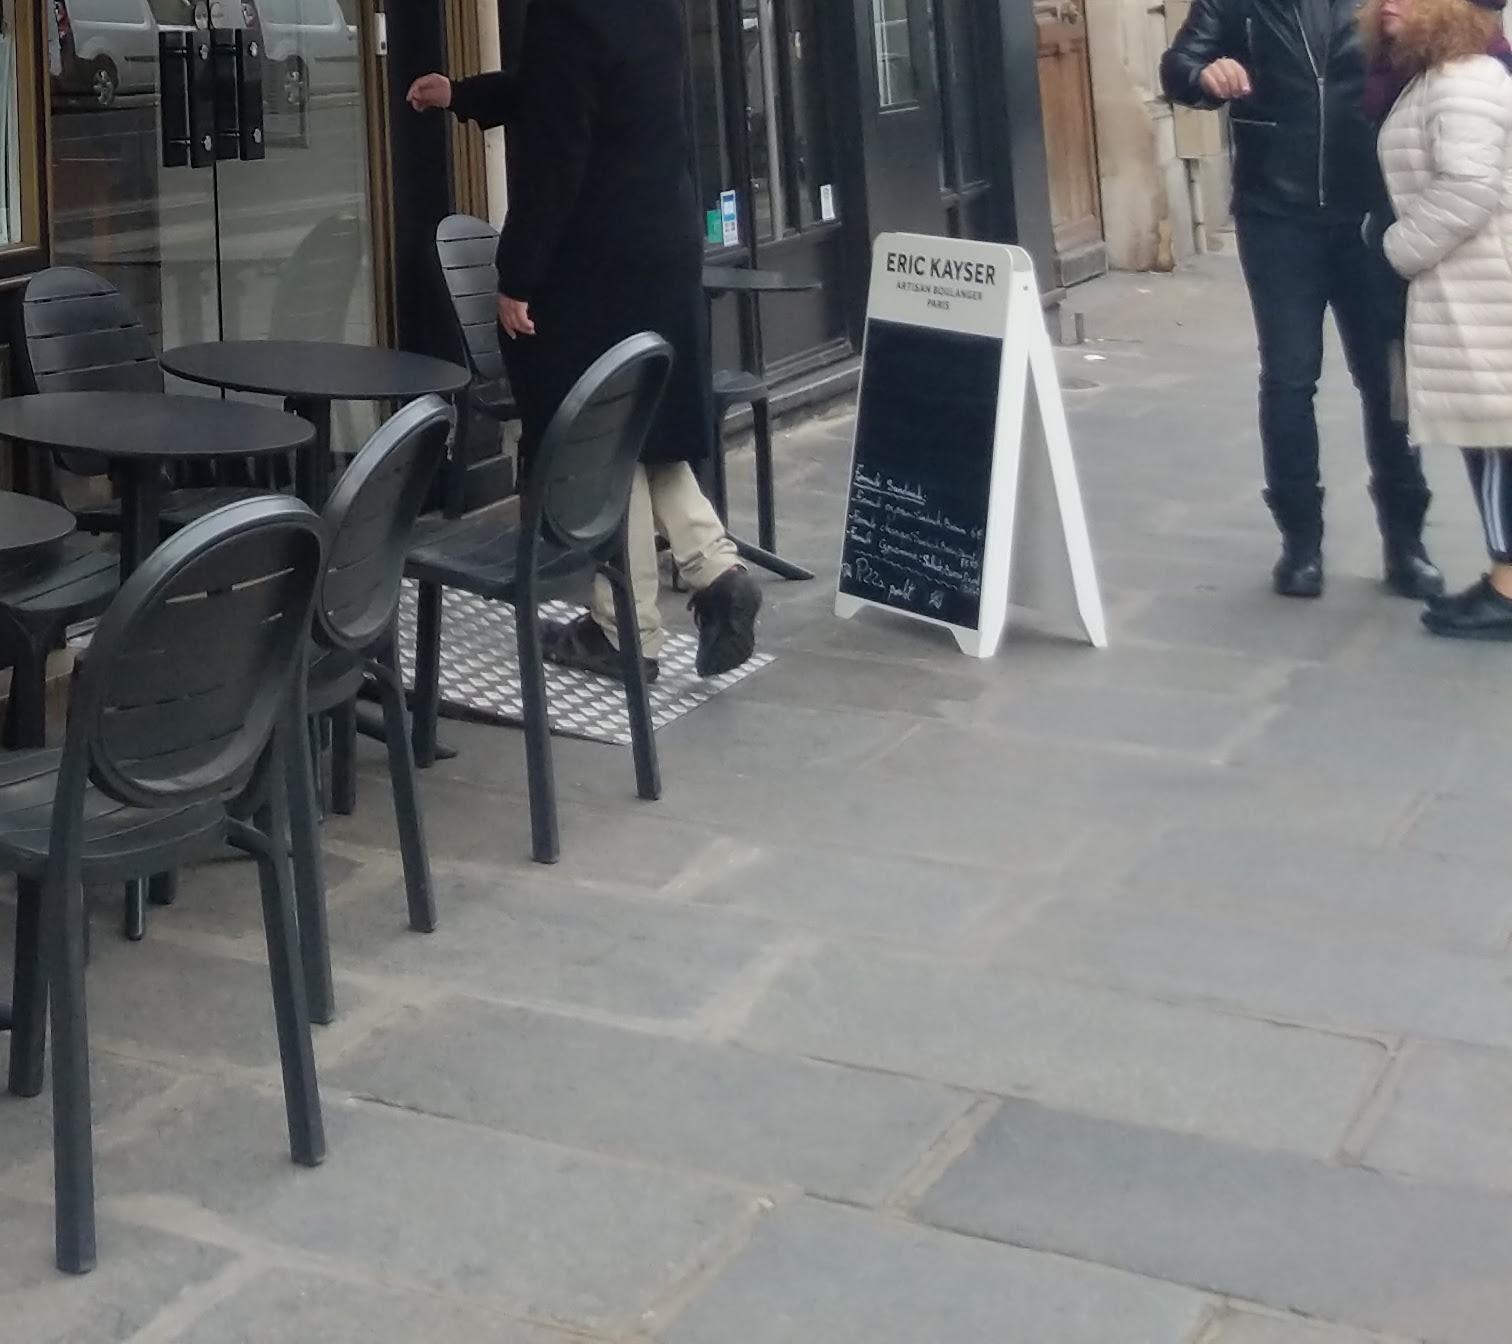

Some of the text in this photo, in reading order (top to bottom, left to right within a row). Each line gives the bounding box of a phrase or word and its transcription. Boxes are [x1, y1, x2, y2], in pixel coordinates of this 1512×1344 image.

[886, 251, 996, 286] ERIC KAYSER
[897, 280, 931, 294] ARTISAN
[927, 298, 950, 311] PARIS
